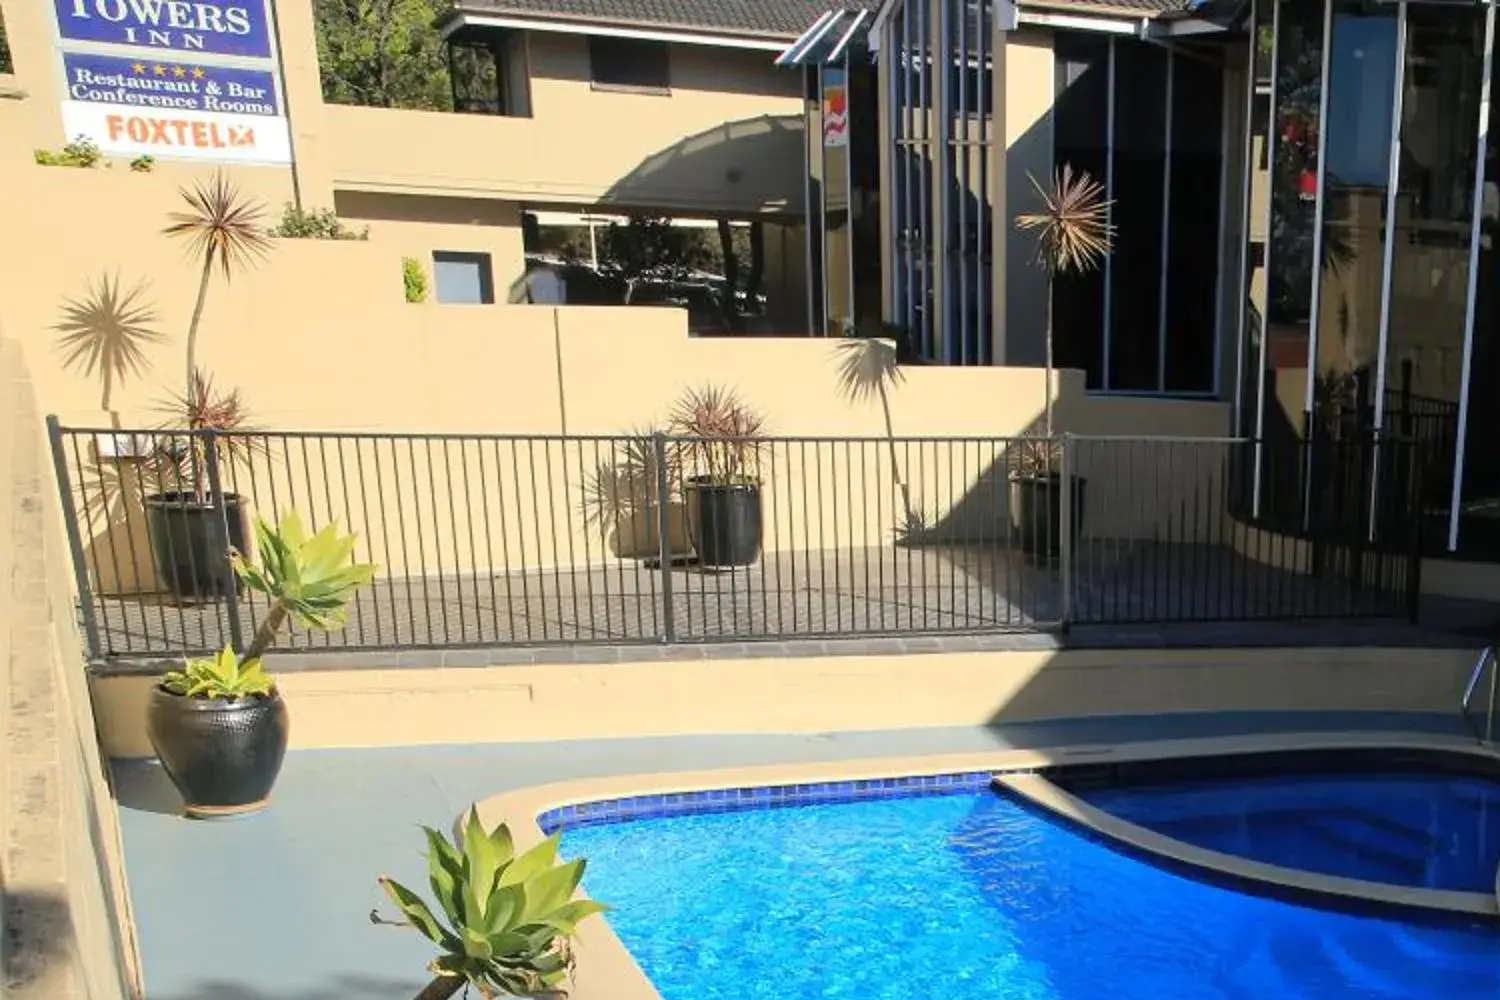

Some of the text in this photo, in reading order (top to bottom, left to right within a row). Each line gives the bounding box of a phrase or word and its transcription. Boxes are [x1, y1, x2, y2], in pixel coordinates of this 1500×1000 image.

[124, 27, 205, 49] INN
[71, 83, 274, 114] Conference Rooms
[74, 67, 267, 99] Restaurant & Bar
[106, 114, 226, 148] FOXTEL
